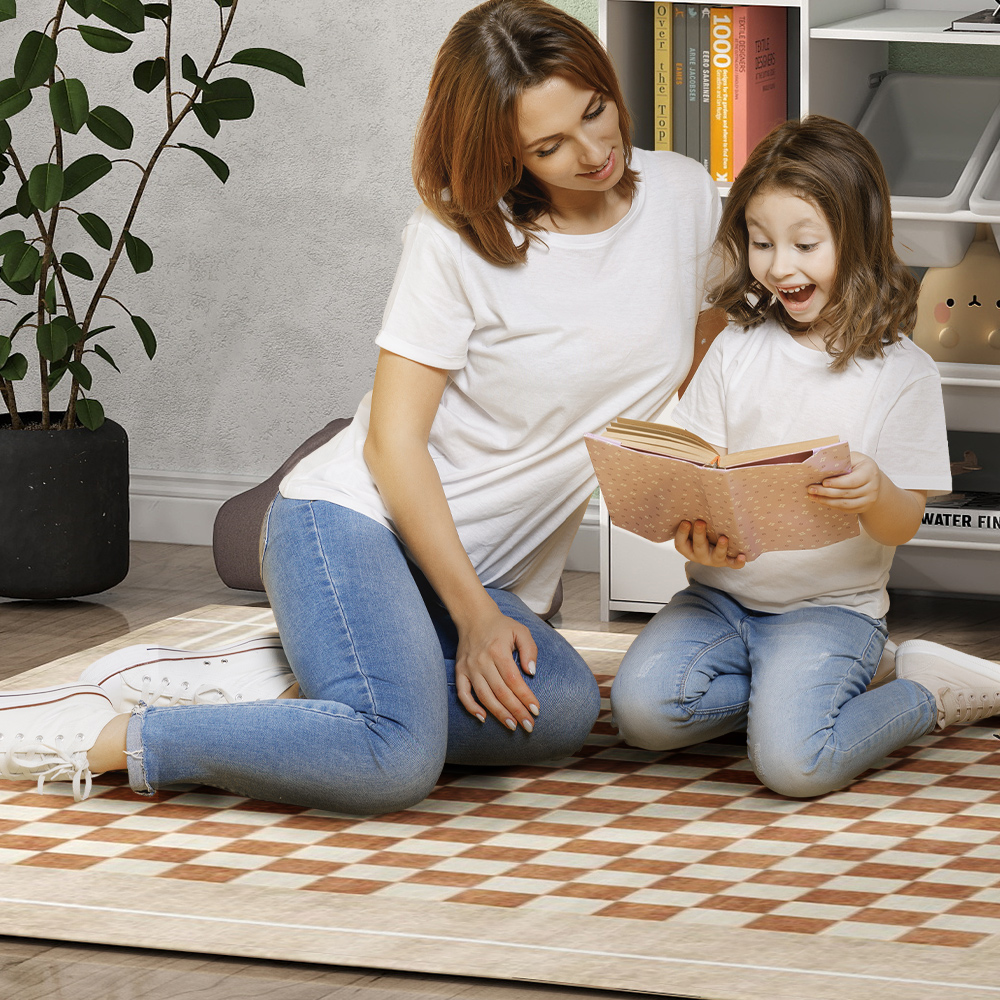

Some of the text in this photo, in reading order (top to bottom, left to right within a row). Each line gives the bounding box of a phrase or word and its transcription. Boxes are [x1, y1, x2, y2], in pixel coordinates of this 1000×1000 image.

[712, 14, 732, 68] 1000
[738, 16, 746, 39] TEXTILE
[657, 5, 667, 142] Over the Top
[921, 513, 971, 528] WATER
